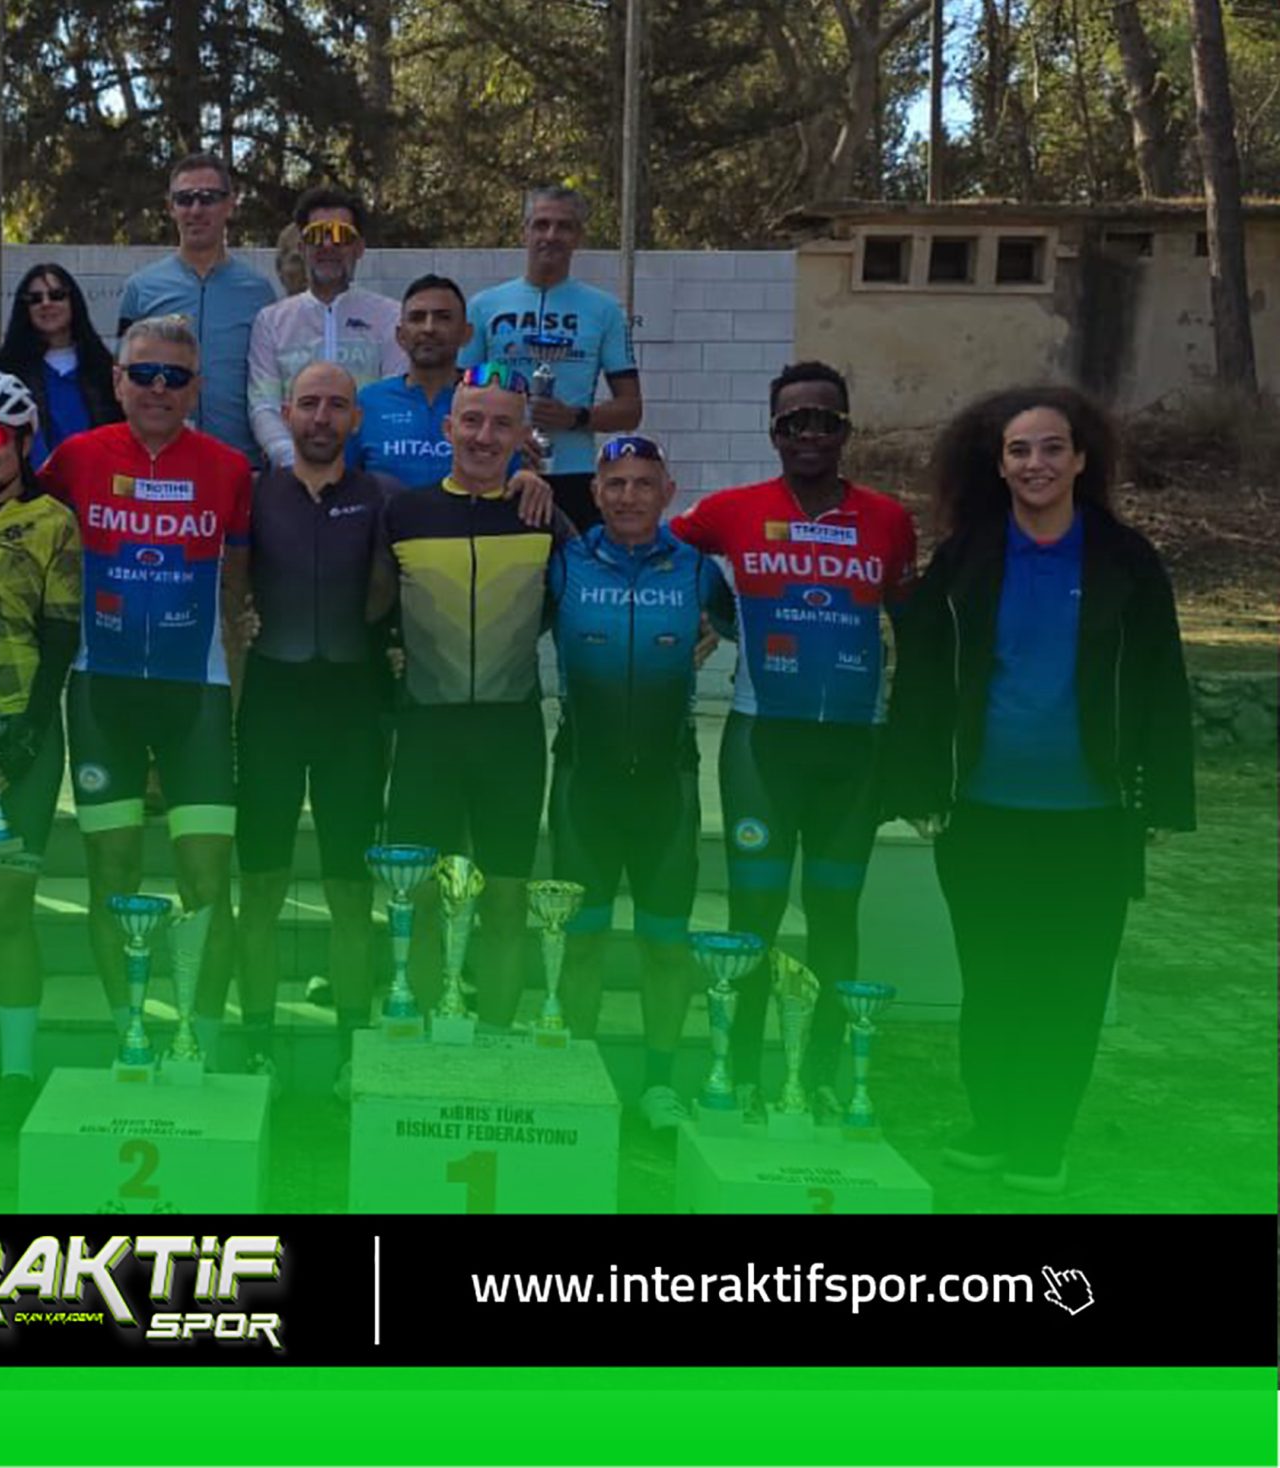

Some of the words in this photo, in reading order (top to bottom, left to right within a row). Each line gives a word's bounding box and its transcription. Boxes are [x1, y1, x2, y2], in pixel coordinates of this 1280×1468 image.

[383, 439, 453, 457] HITAC
[88, 504, 151, 535] EMU
[155, 510, 218, 537] DAÜ
[743, 552, 812, 576] EMU
[818, 555, 883, 584] DAÜ
[581, 587, 684, 607] HITACHI
[440, 1105, 490, 1122] KIBRIS
[497, 1105, 535, 1125] TÜRK
[467, 1123, 579, 1146] FEDERASYONU
[119, 1138, 160, 1199] 2
[447, 1150, 497, 1214] 1
